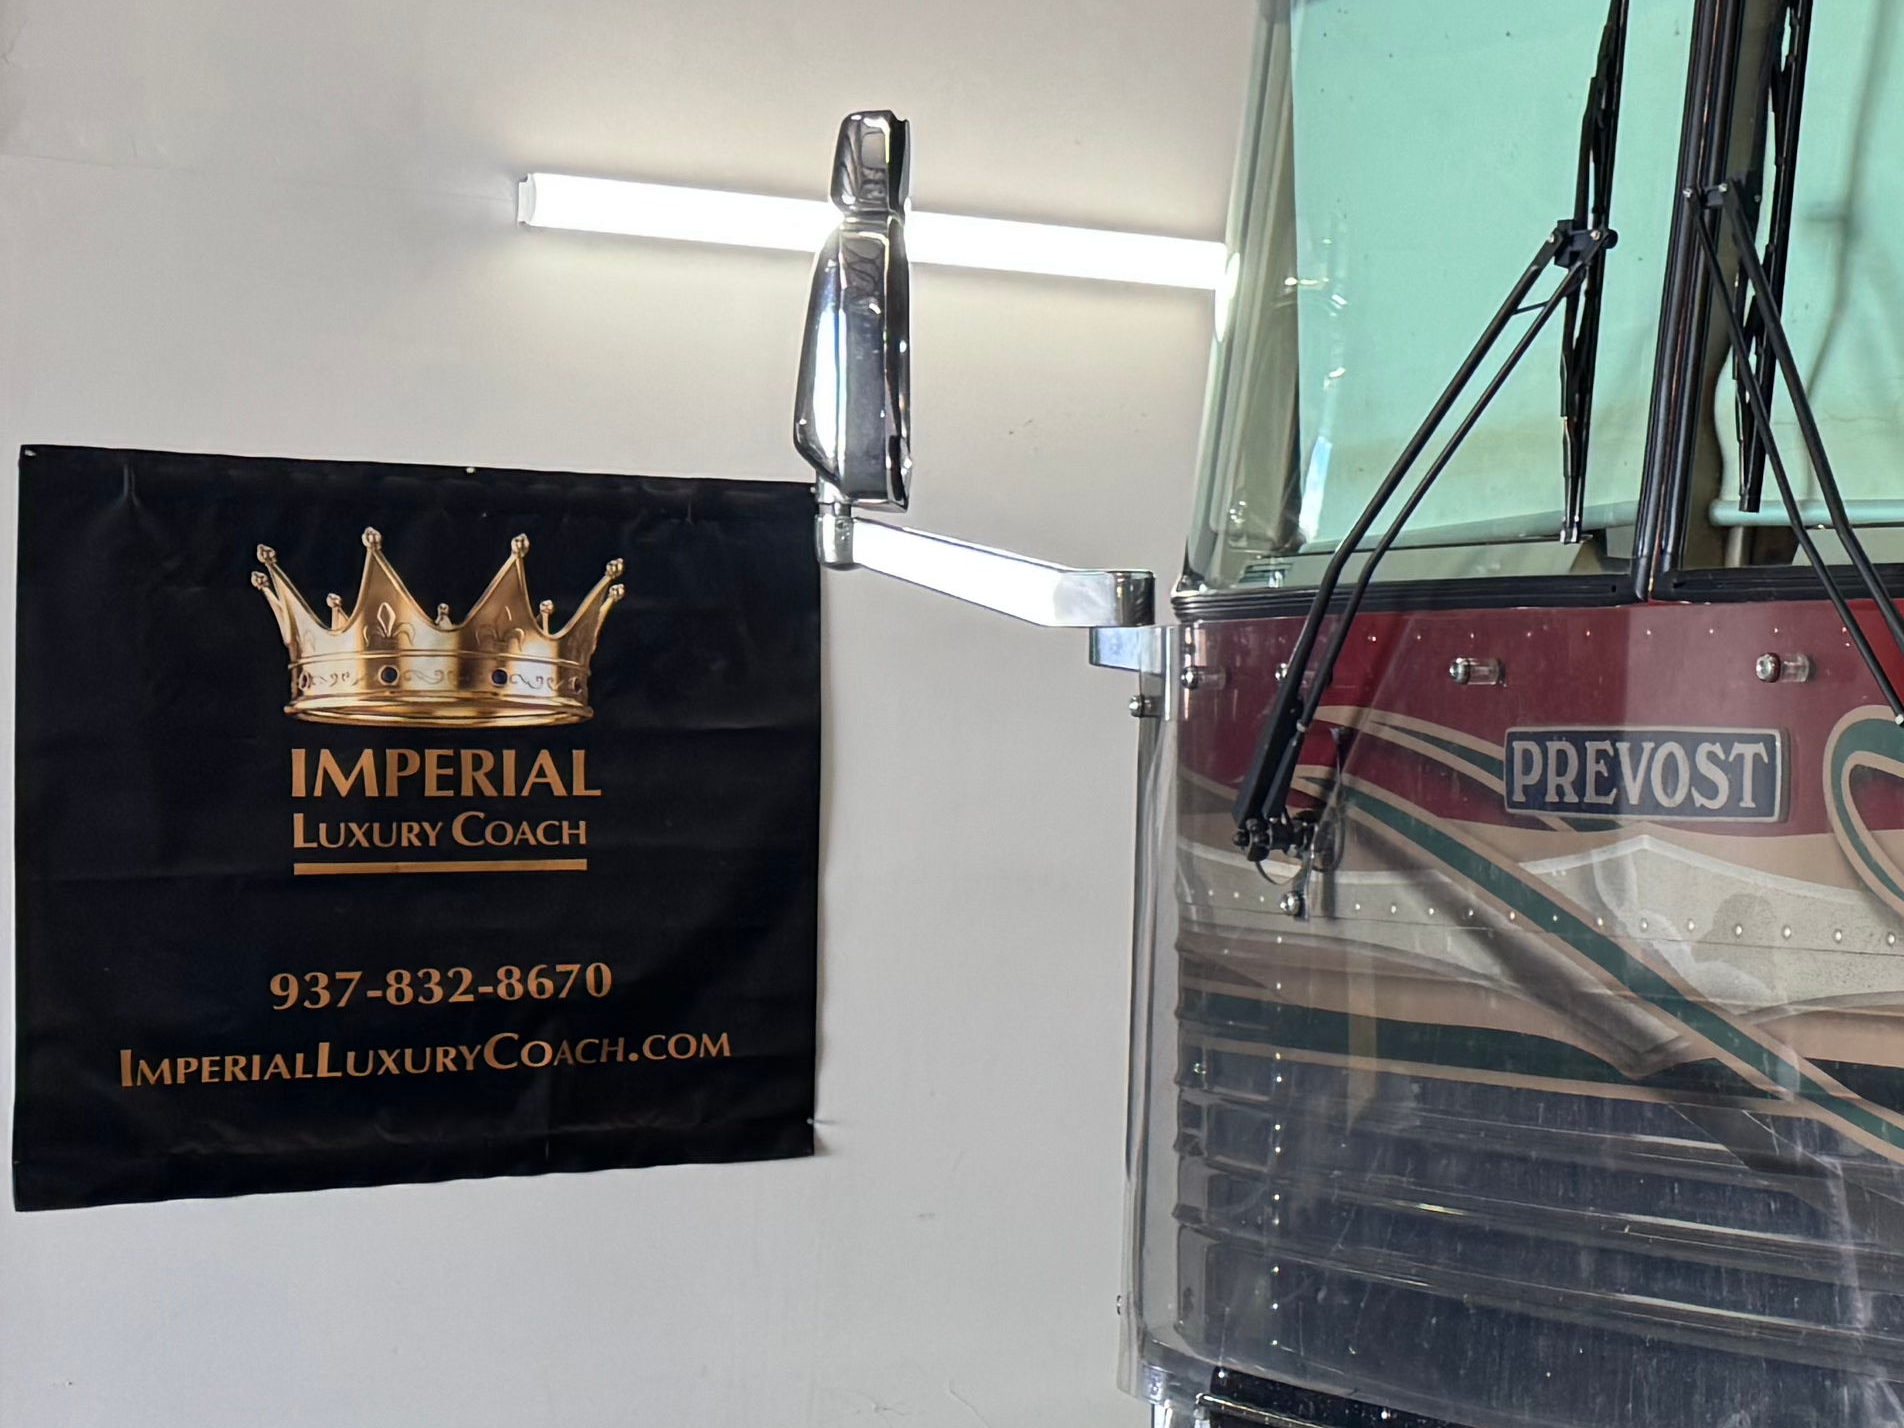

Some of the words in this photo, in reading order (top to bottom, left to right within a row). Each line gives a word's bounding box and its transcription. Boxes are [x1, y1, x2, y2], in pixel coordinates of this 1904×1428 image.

[291, 747, 602, 798] IMPERIAL
[1511, 739, 1769, 810] PREVOST
[268, 961, 613, 1011] 937-832-8670
